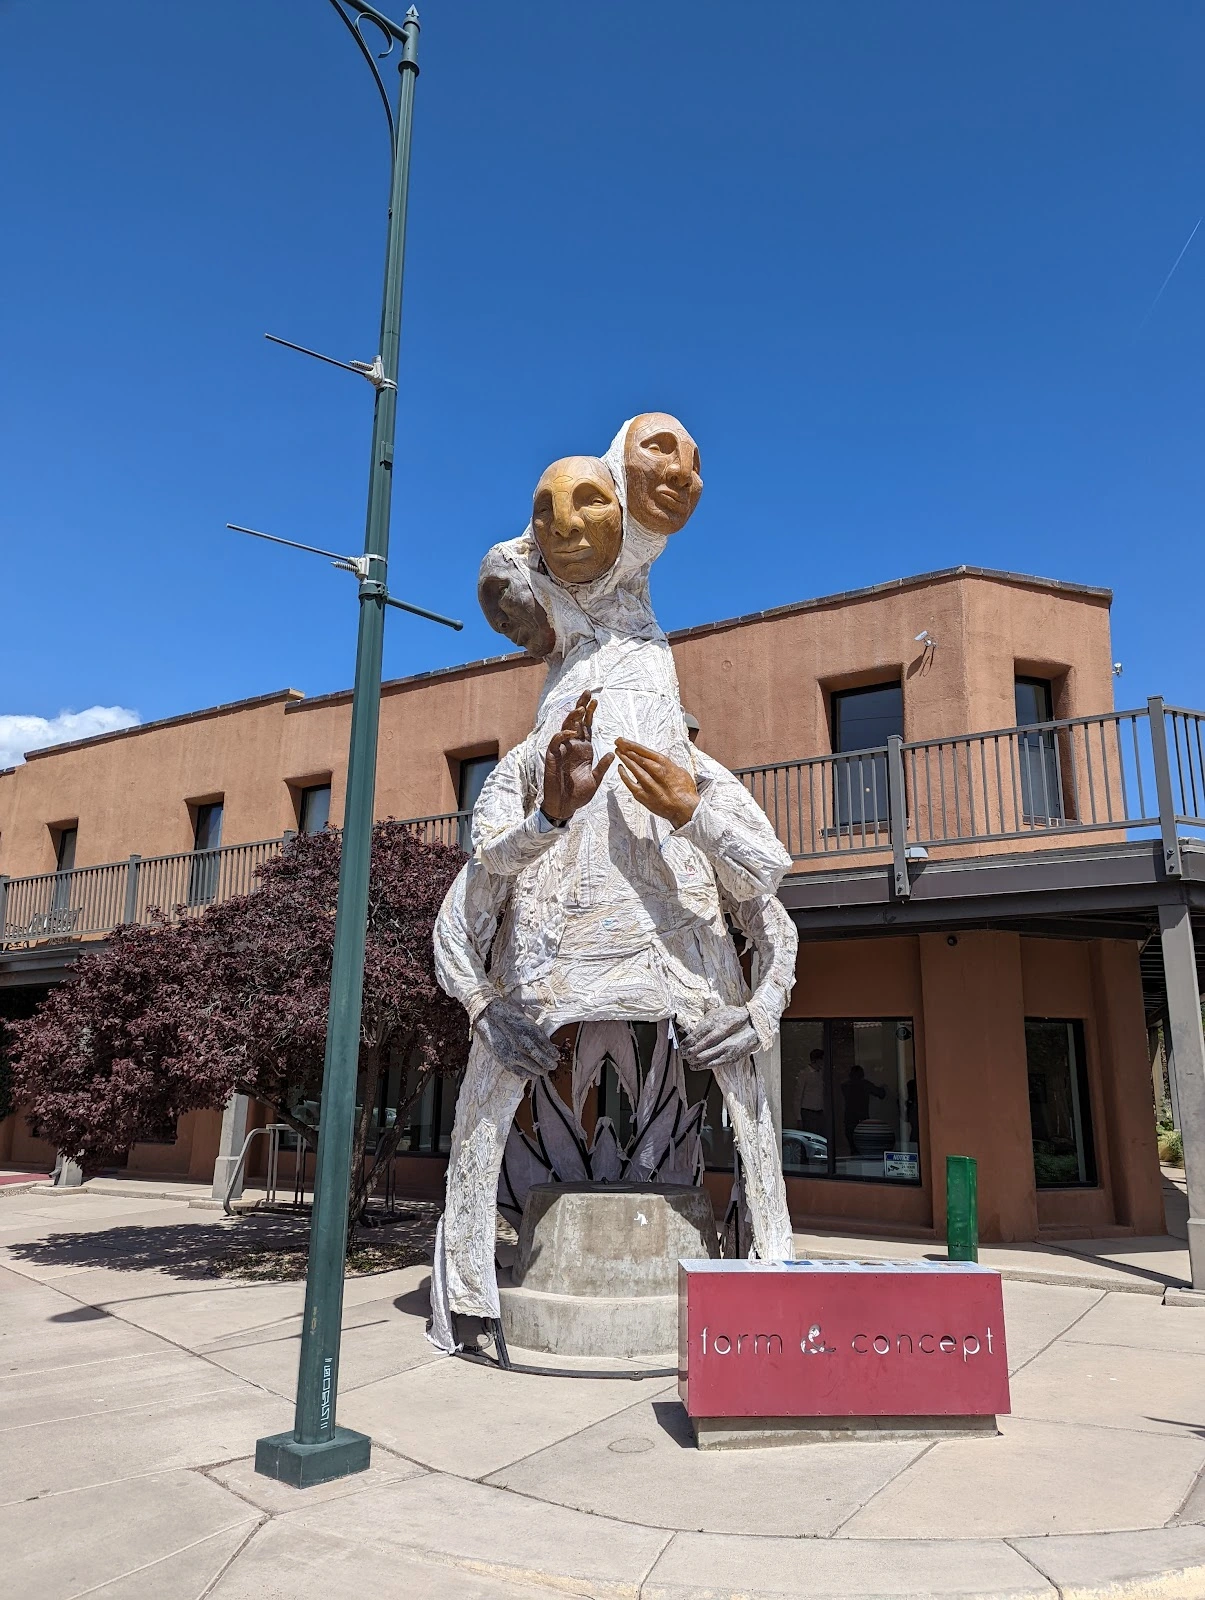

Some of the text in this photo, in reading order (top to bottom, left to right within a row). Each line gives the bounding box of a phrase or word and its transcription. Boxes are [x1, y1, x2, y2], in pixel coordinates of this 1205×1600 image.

[700, 1324, 994, 1362] form & concept
